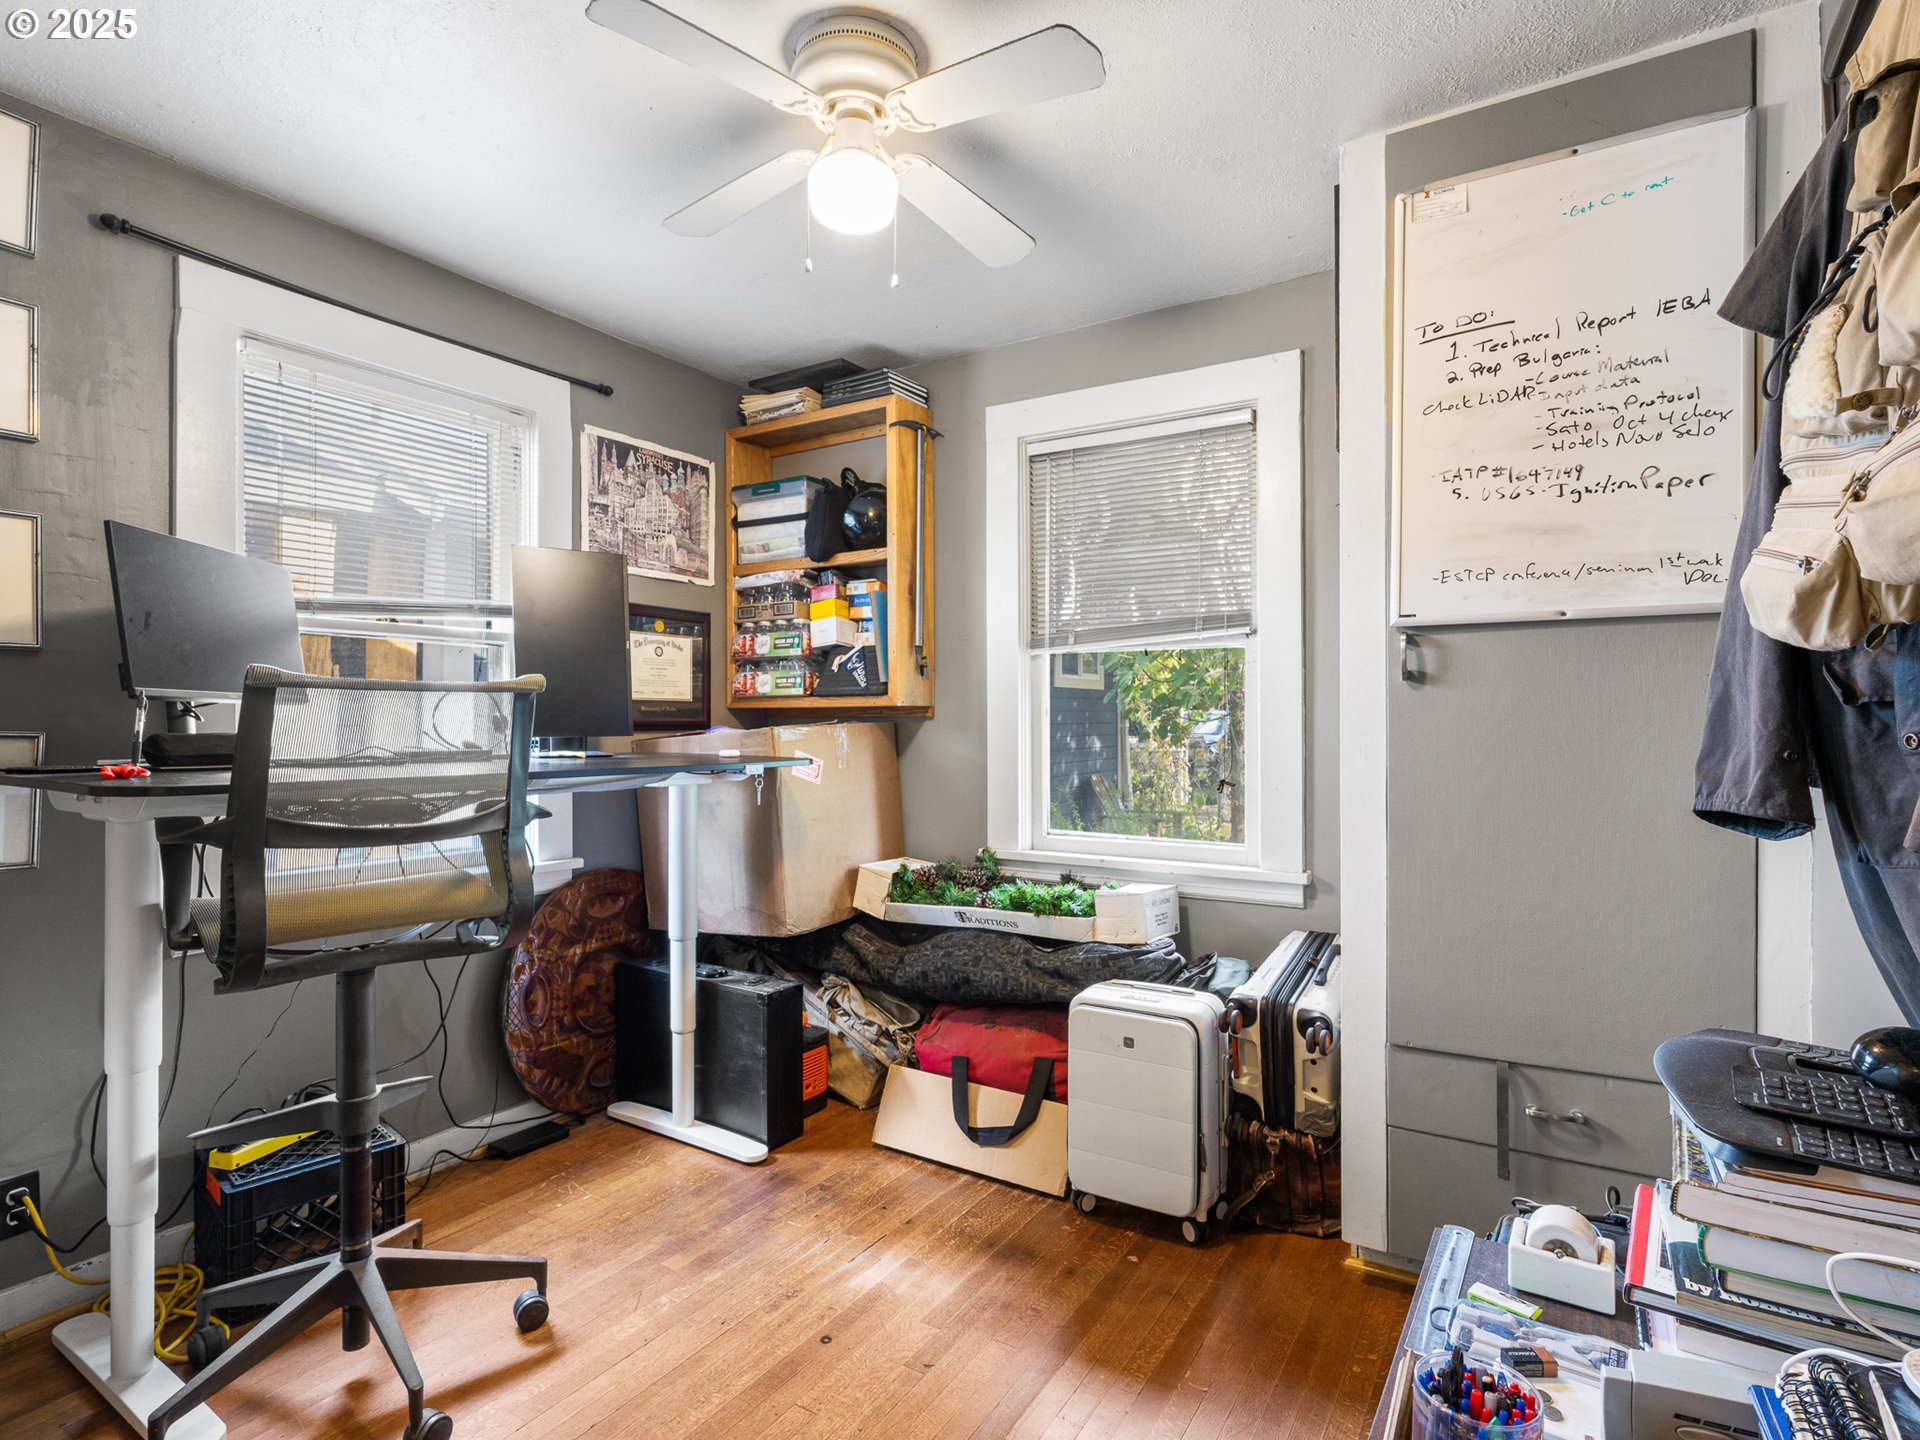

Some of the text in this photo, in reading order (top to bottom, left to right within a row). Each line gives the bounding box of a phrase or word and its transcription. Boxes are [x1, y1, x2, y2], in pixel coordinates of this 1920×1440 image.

[1414, 322, 1444, 338] To
[1445, 341, 1467, 362] 1.
[1473, 318, 1560, 352] Technical
[1576, 305, 1636, 336] Report
[1598, 348, 1670, 373] Material
[1445, 371, 1463, 384] 2.
[1469, 362, 1501, 378] Prep
[1624, 386, 1700, 410] Protocol
[1613, 415, 1647, 430] Oct
[1659, 410, 1673, 425] 4
[636, 453, 674, 474] SYRACUSE
[1640, 465, 1718, 497] Paper
[954, 911, 1019, 929] TRADITIONS
[1682, 1277, 1713, 1297] by
